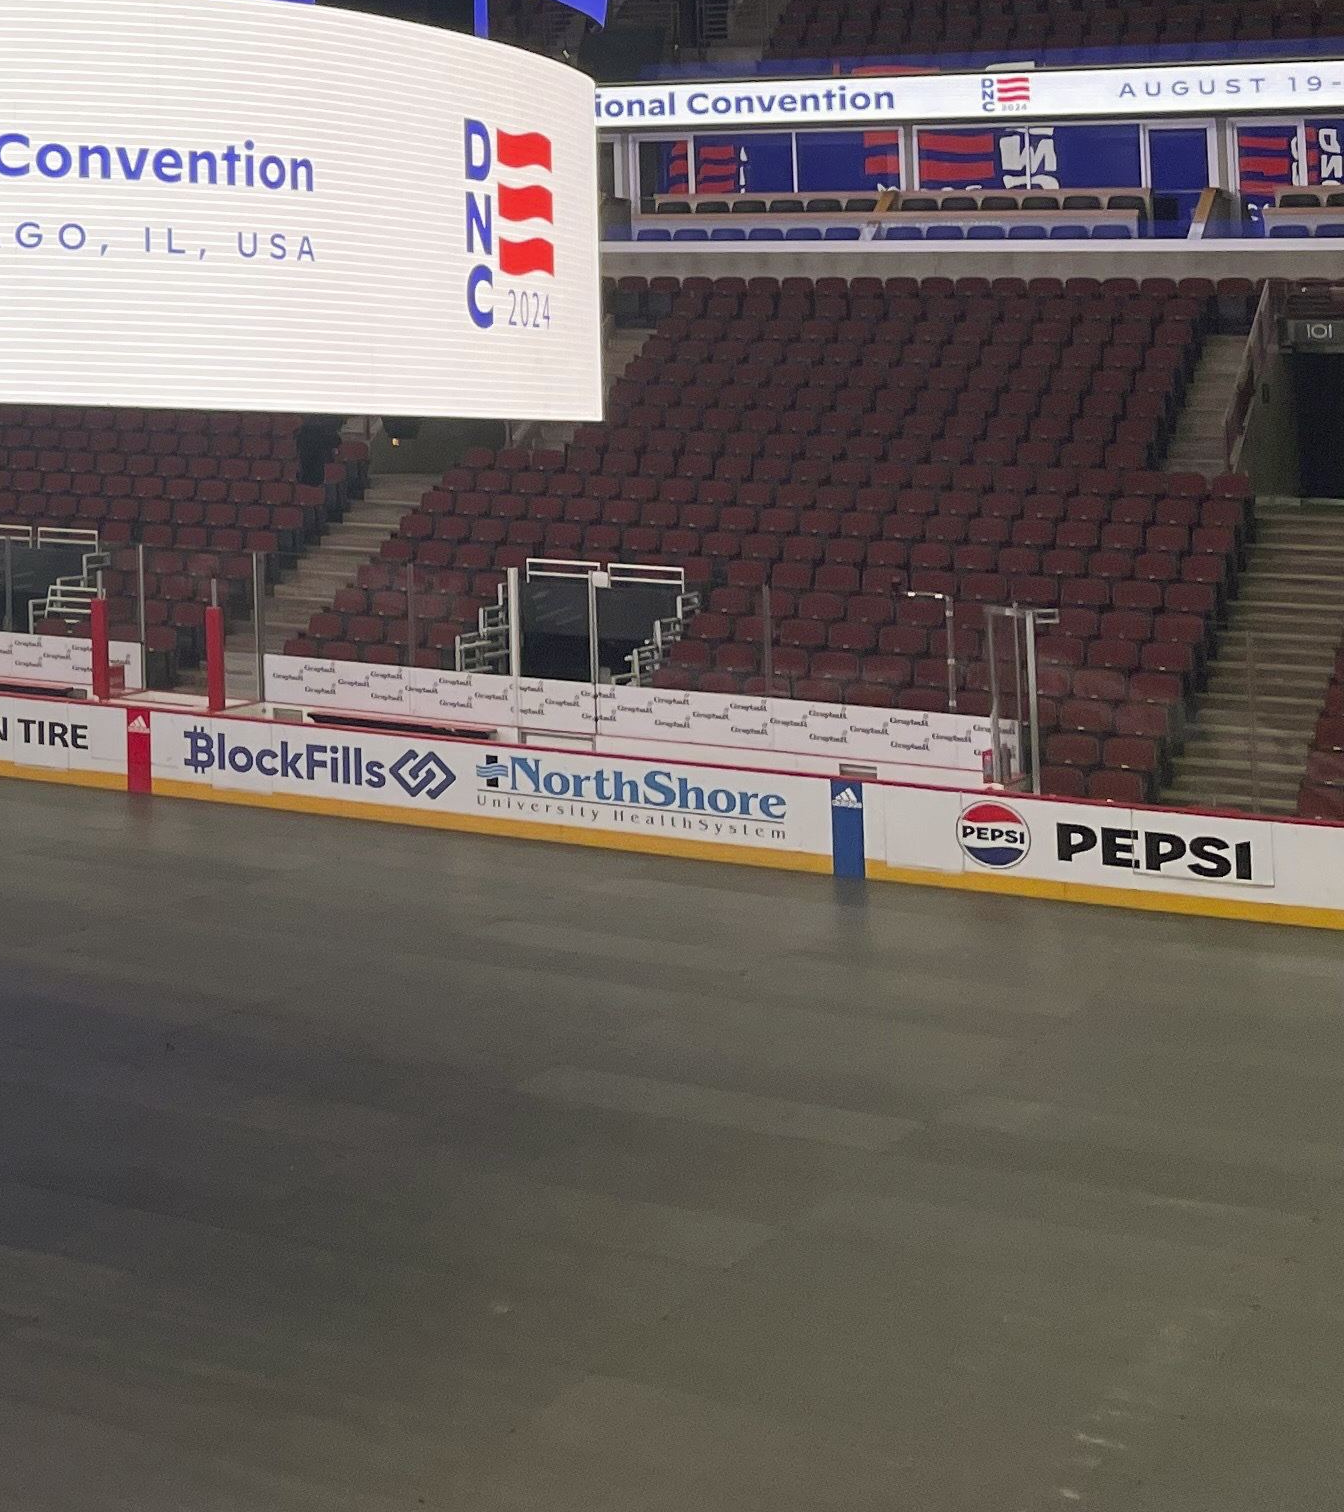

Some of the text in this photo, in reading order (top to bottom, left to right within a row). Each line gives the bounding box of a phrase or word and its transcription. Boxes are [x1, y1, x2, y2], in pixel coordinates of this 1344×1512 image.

[686, 83, 896, 118] Convention
[1118, 76, 1267, 100] AUGUST
[143, 225, 207, 261] IL,
[237, 229, 317, 264] USA
[507, 288, 551, 331] 2024
[18, 715, 91, 751] TIRE
[182, 724, 388, 791] BlockFills
[508, 754, 789, 821] NorthShore
[475, 793, 789, 842] University HealthSystem
[961, 824, 1026, 846] PEPSI
[1056, 821, 1254, 882] PEPSI
